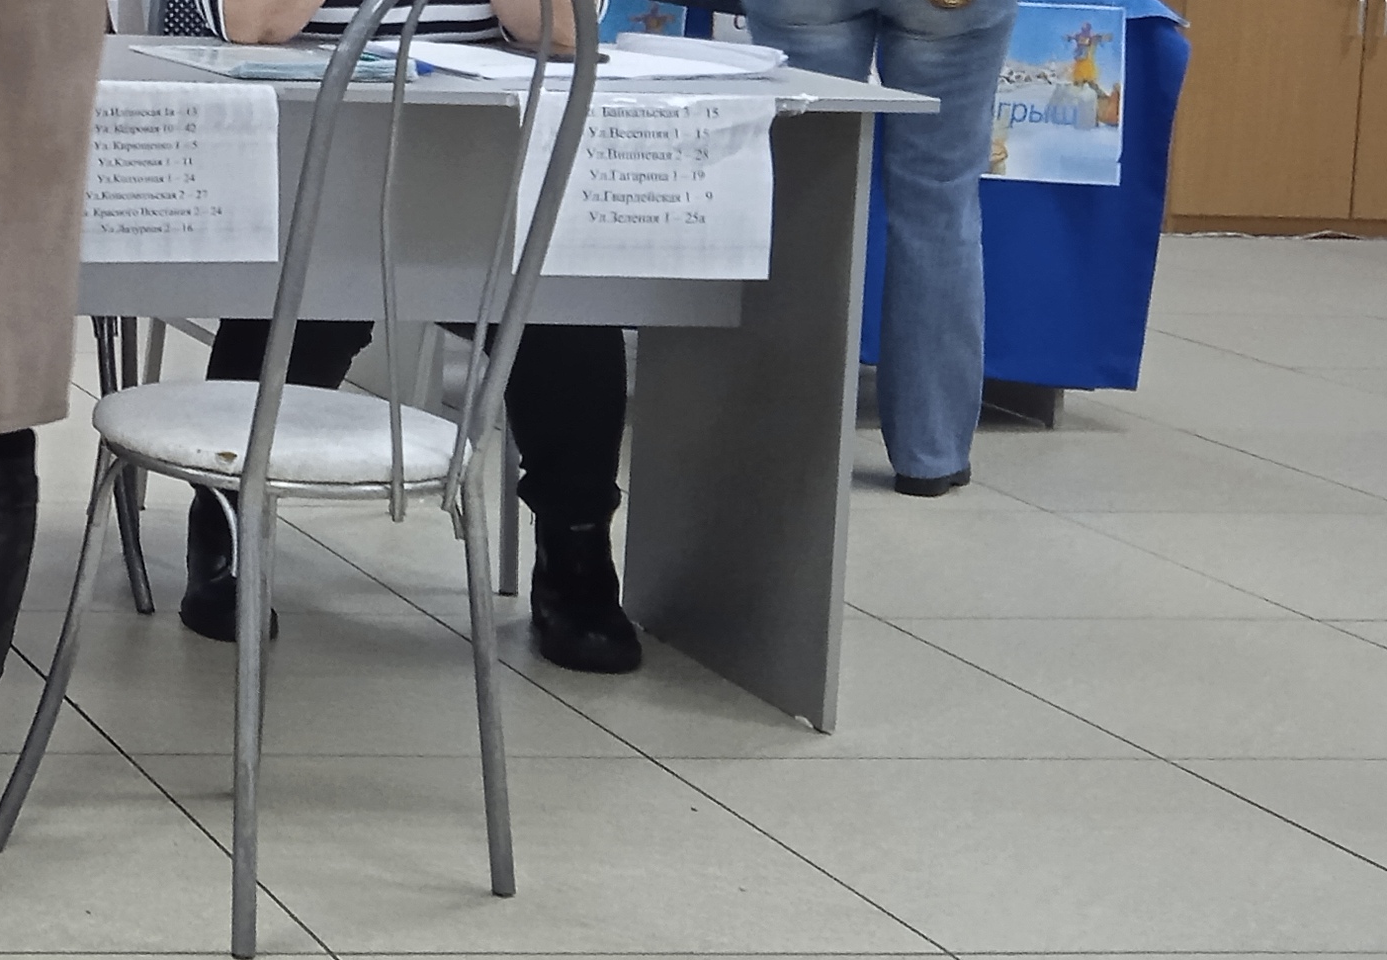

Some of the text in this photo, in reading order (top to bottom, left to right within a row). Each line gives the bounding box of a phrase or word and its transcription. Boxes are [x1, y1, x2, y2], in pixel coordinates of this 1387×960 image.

[601, 106, 680, 119] Байкальская
[705, 107, 720, 119] 15
[991, 102, 1078, 129] грыш
